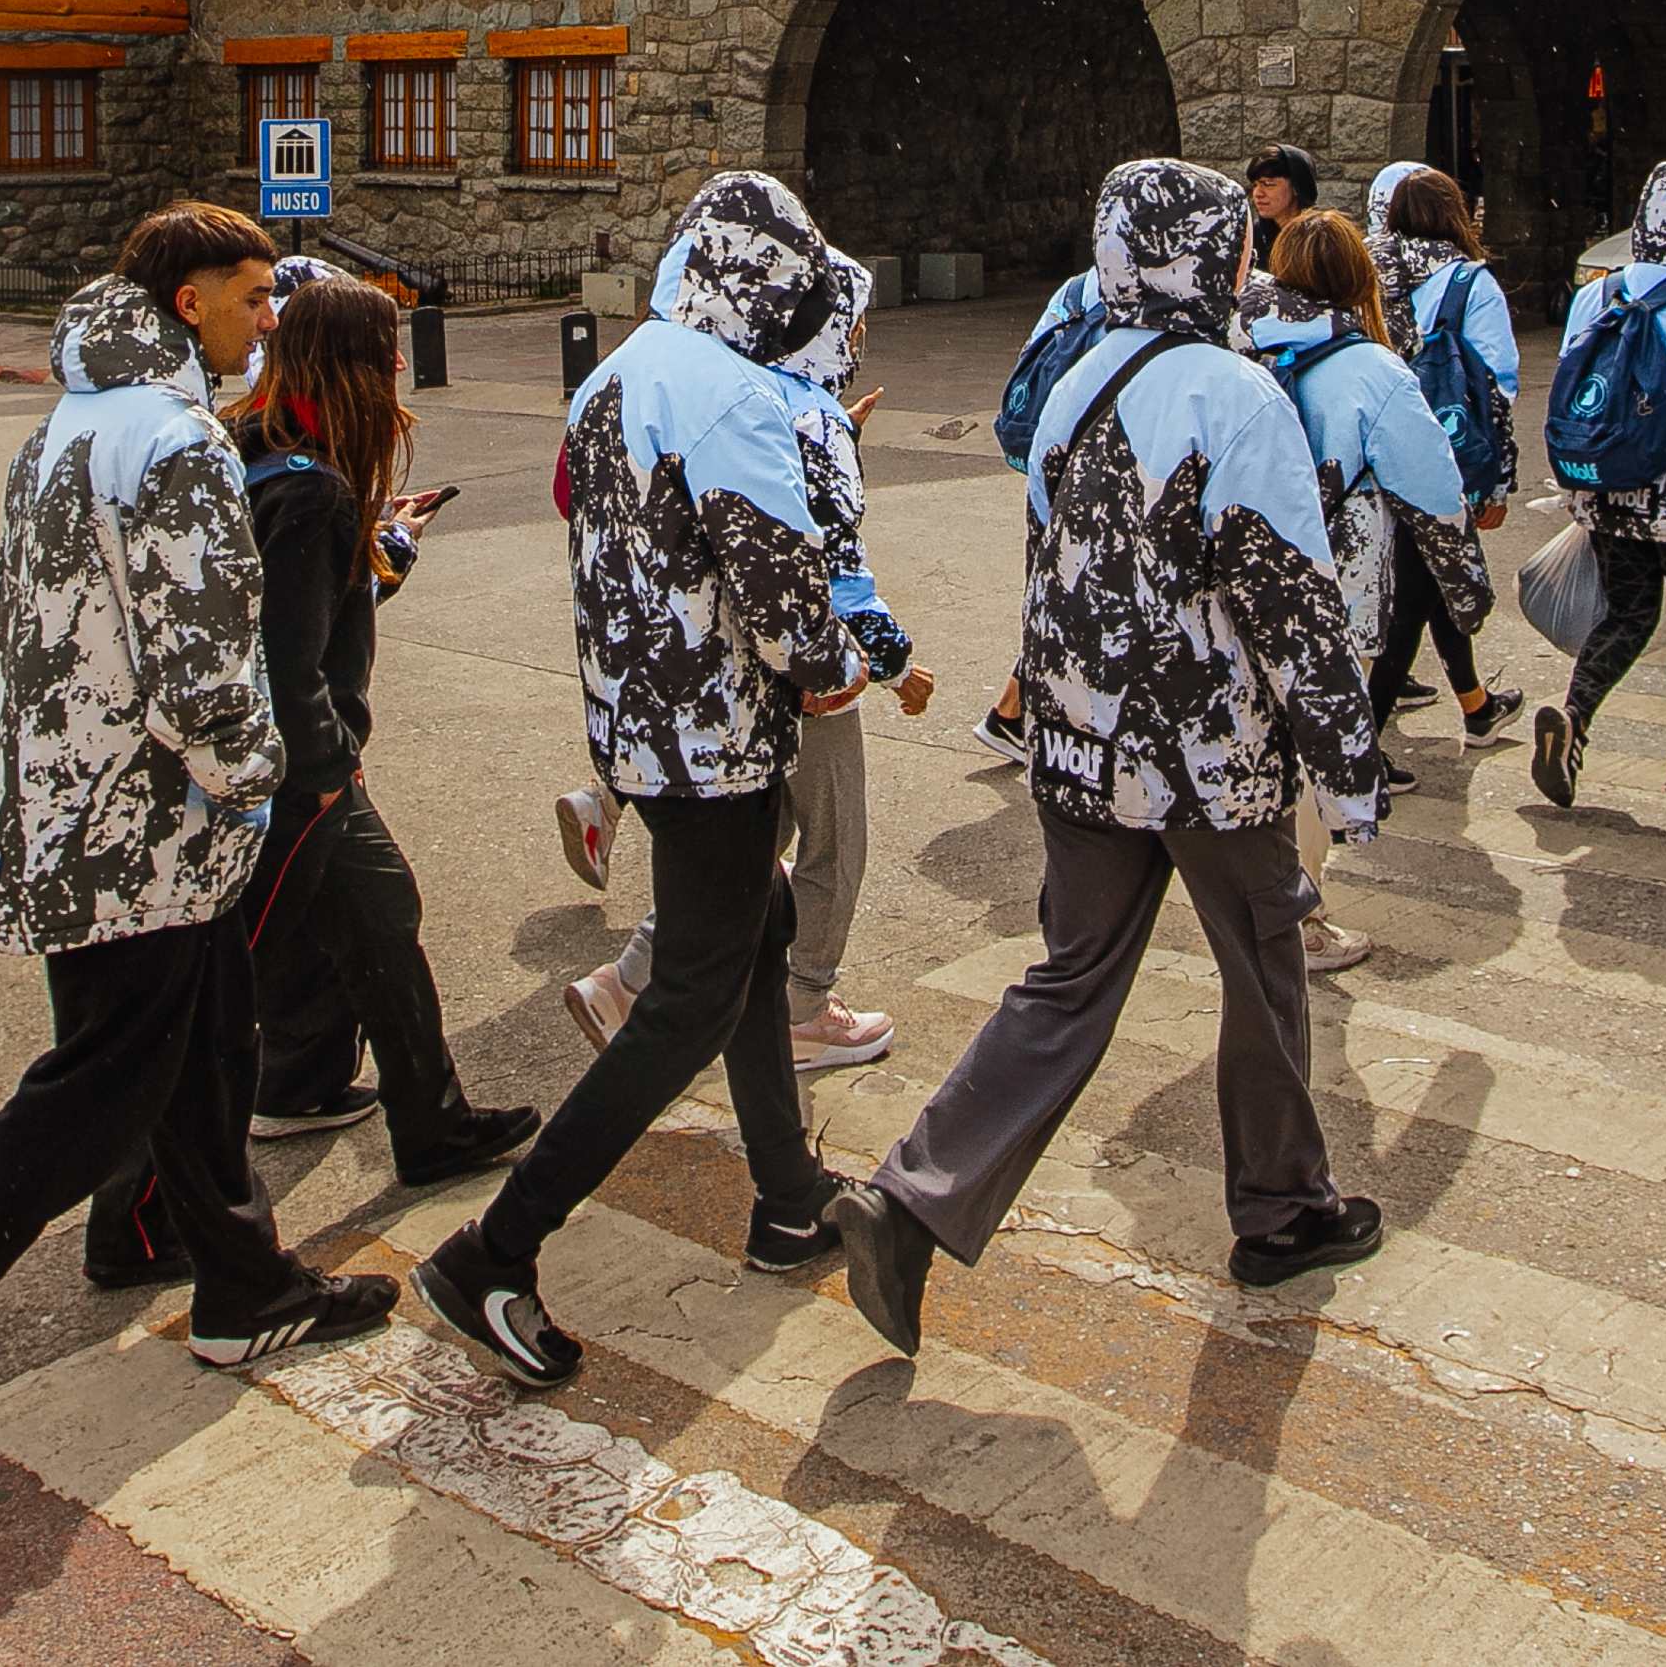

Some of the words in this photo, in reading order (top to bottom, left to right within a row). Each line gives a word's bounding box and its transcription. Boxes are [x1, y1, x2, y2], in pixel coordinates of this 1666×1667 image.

[271, 192, 320, 211] MUSEO
[1558, 460, 1599, 481] Wolf
[1043, 727, 1103, 781] Wolf
